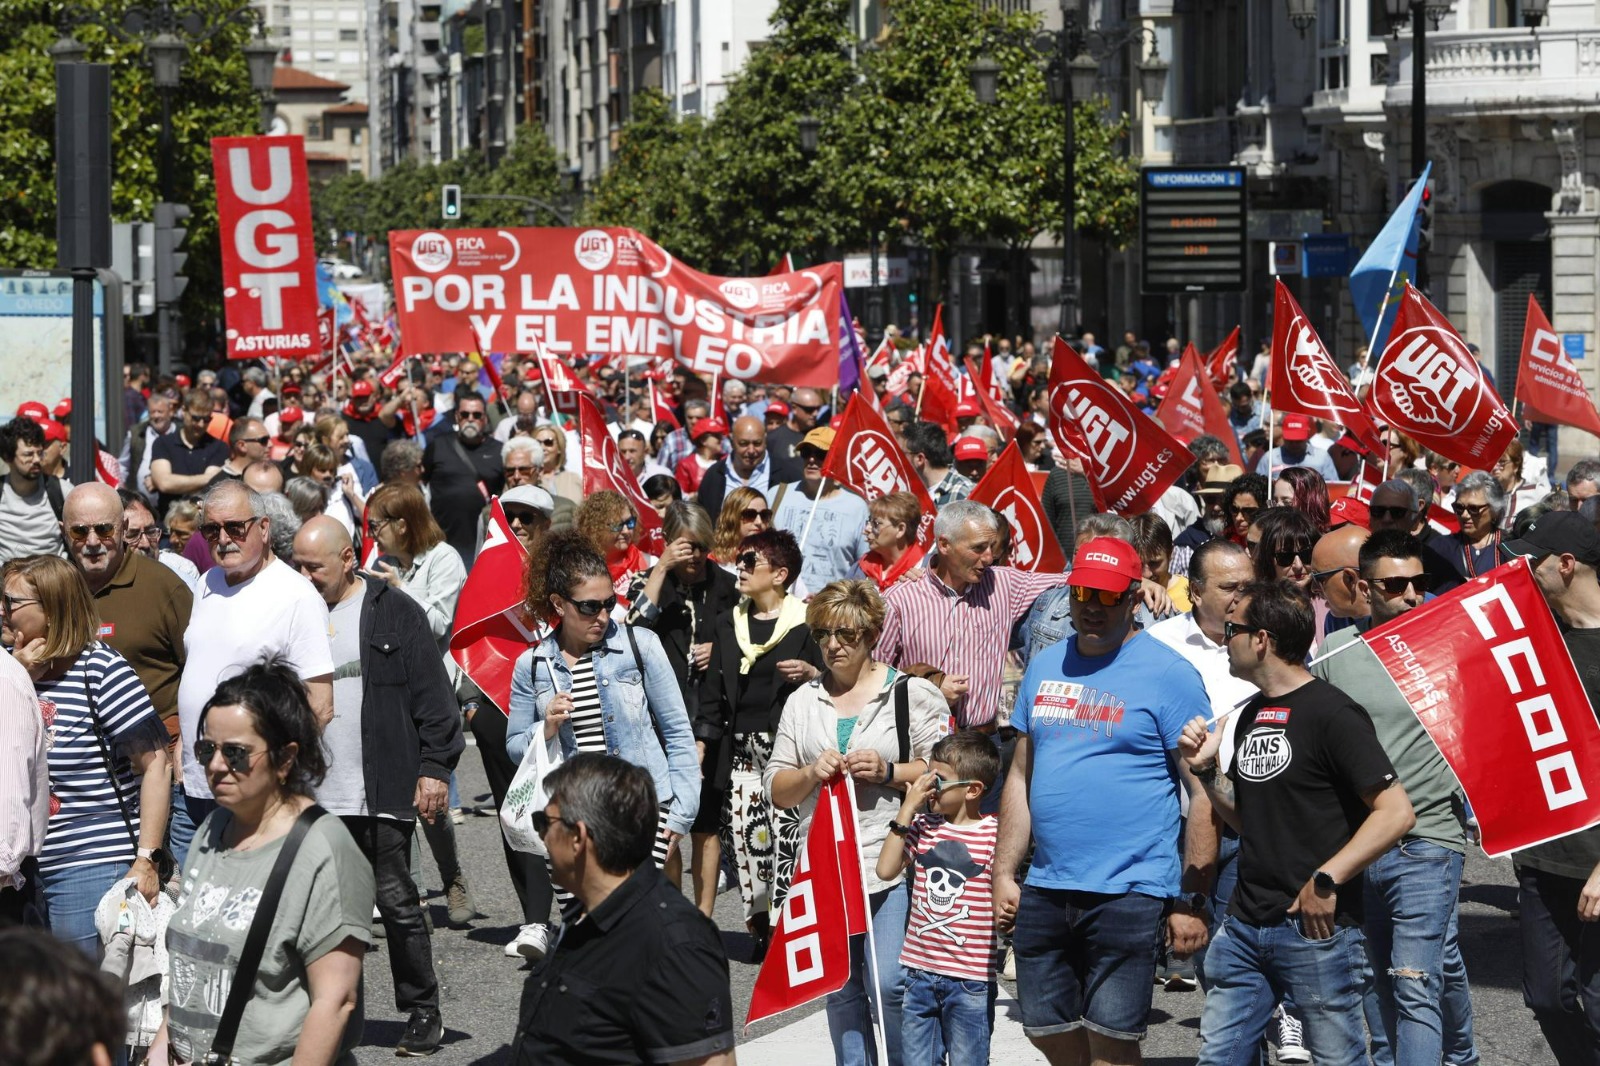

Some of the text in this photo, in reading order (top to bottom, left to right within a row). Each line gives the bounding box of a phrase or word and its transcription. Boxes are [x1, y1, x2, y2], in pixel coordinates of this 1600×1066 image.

[1153, 173, 1225, 185] INFORMACIÓN
[228, 146, 300, 330] UGT
[417, 240, 446, 255] UGT
[456, 238, 485, 249] FICA
[761, 281, 790, 295] FICA
[402, 274, 506, 312] POR
[520, 274, 580, 310] LA
[593, 274, 831, 345] INDUSTRIA
[235, 333, 311, 351] ASTURIAS
[469, 314, 763, 379] Y EL EMPLEO
[1393, 334, 1477, 412] UGT
[1528, 361, 1565, 380] servicios
[1566, 374, 1573, 383] a
[1062, 387, 1130, 467] UGT
[1085, 552, 1119, 566] CCOO
[1384, 634, 1442, 706] ASTURIAS
[1459, 583, 1588, 811] CCOO
[1242, 732, 1282, 758] VANS
[1251, 757, 1265, 774] THE
